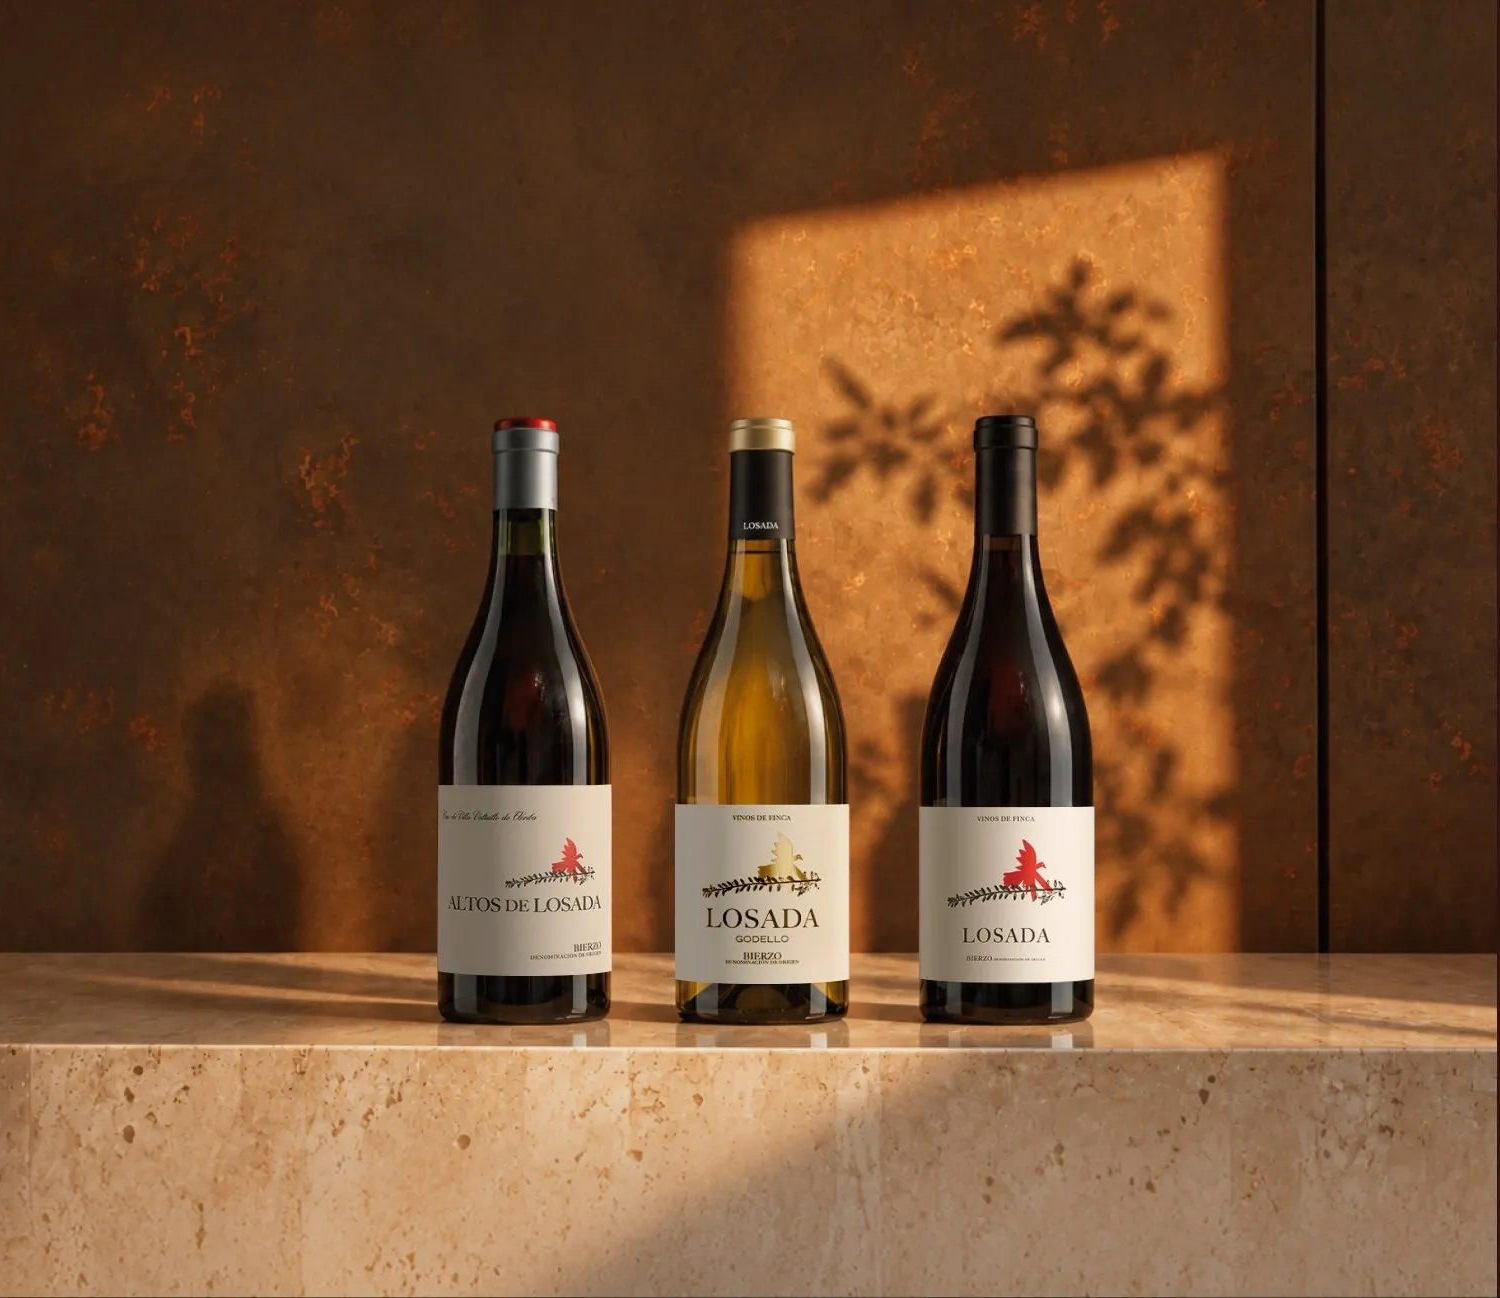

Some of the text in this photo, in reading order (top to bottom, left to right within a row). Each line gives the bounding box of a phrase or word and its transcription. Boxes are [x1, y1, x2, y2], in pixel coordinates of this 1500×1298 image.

[743, 521, 779, 530] LOSADA
[448, 895, 602, 913] ALTOS DE LOSADA
[706, 907, 819, 929] LOSADA
[735, 935, 789, 943] GODELLO
[962, 927, 1050, 943] LOSADA
[573, 941, 602, 952] BIERZO
[743, 951, 782, 960] BIERZO
